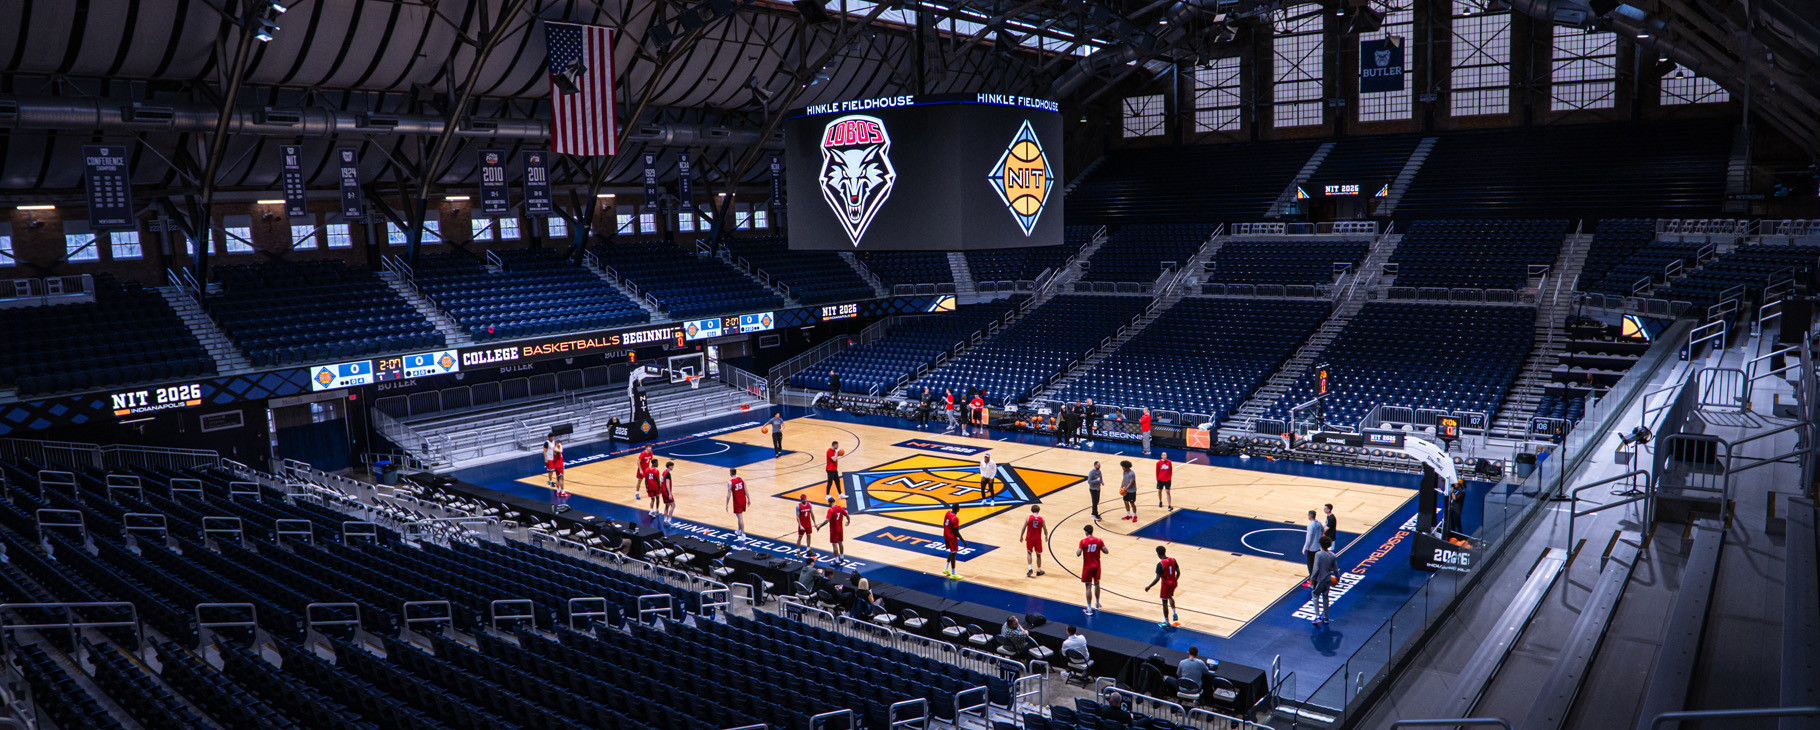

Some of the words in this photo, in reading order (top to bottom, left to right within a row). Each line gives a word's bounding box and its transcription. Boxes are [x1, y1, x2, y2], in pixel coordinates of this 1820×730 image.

[1362, 66, 1402, 77] BUTLER
[806, 102, 839, 116] HINKLE
[842, 94, 914, 111] FIELDHOUSE
[977, 92, 1015, 105] HINKLE
[1018, 96, 1059, 112] FIELDHOUSE
[825, 120, 884, 147] LOBOS
[86, 157, 124, 166] CONFERENCE
[286, 155, 297, 166] NIT
[341, 167, 357, 178] 1924
[482, 167, 504, 182] 2010
[528, 167, 546, 182] 2011
[1008, 167, 1043, 189] NIT
[1325, 185, 1339, 193] NIT
[1341, 184, 1360, 192] 2026
[822, 306, 837, 317] NIT
[839, 303, 857, 315] 2026
[707, 320, 714, 329] 0
[725, 317, 739, 327] 2:07
[746, 315, 753, 324] 0
[678, 336, 684, 348] 0
[463, 346, 519, 366] COLLEGE
[523, 335, 621, 357] BASKETBALL'S
[379, 358, 402, 371] 2:07
[415, 356, 424, 366] 0
[350, 364, 360, 374] 0
[377, 379, 417, 391] BUTLER
[111, 390, 149, 409] NIT
[156, 384, 201, 403] 2026
[131, 401, 186, 413] INDIANAPOLIS
[639, 395, 647, 412] NIT
[1470, 417, 1480, 425] 107
[1446, 426, 1453, 436] 0
[906, 441, 944, 450] NIT
[940, 445, 977, 453] 2026
[734, 482, 743, 491] 35
[882, 476, 990, 497] NIT
[672, 521, 736, 540] HINKLE
[876, 532, 932, 546] NIT
[1087, 544, 1097, 552] 10
[1351, 530, 1410, 575] BASKETBALL'S
[1169, 565, 1173, 575] 1
